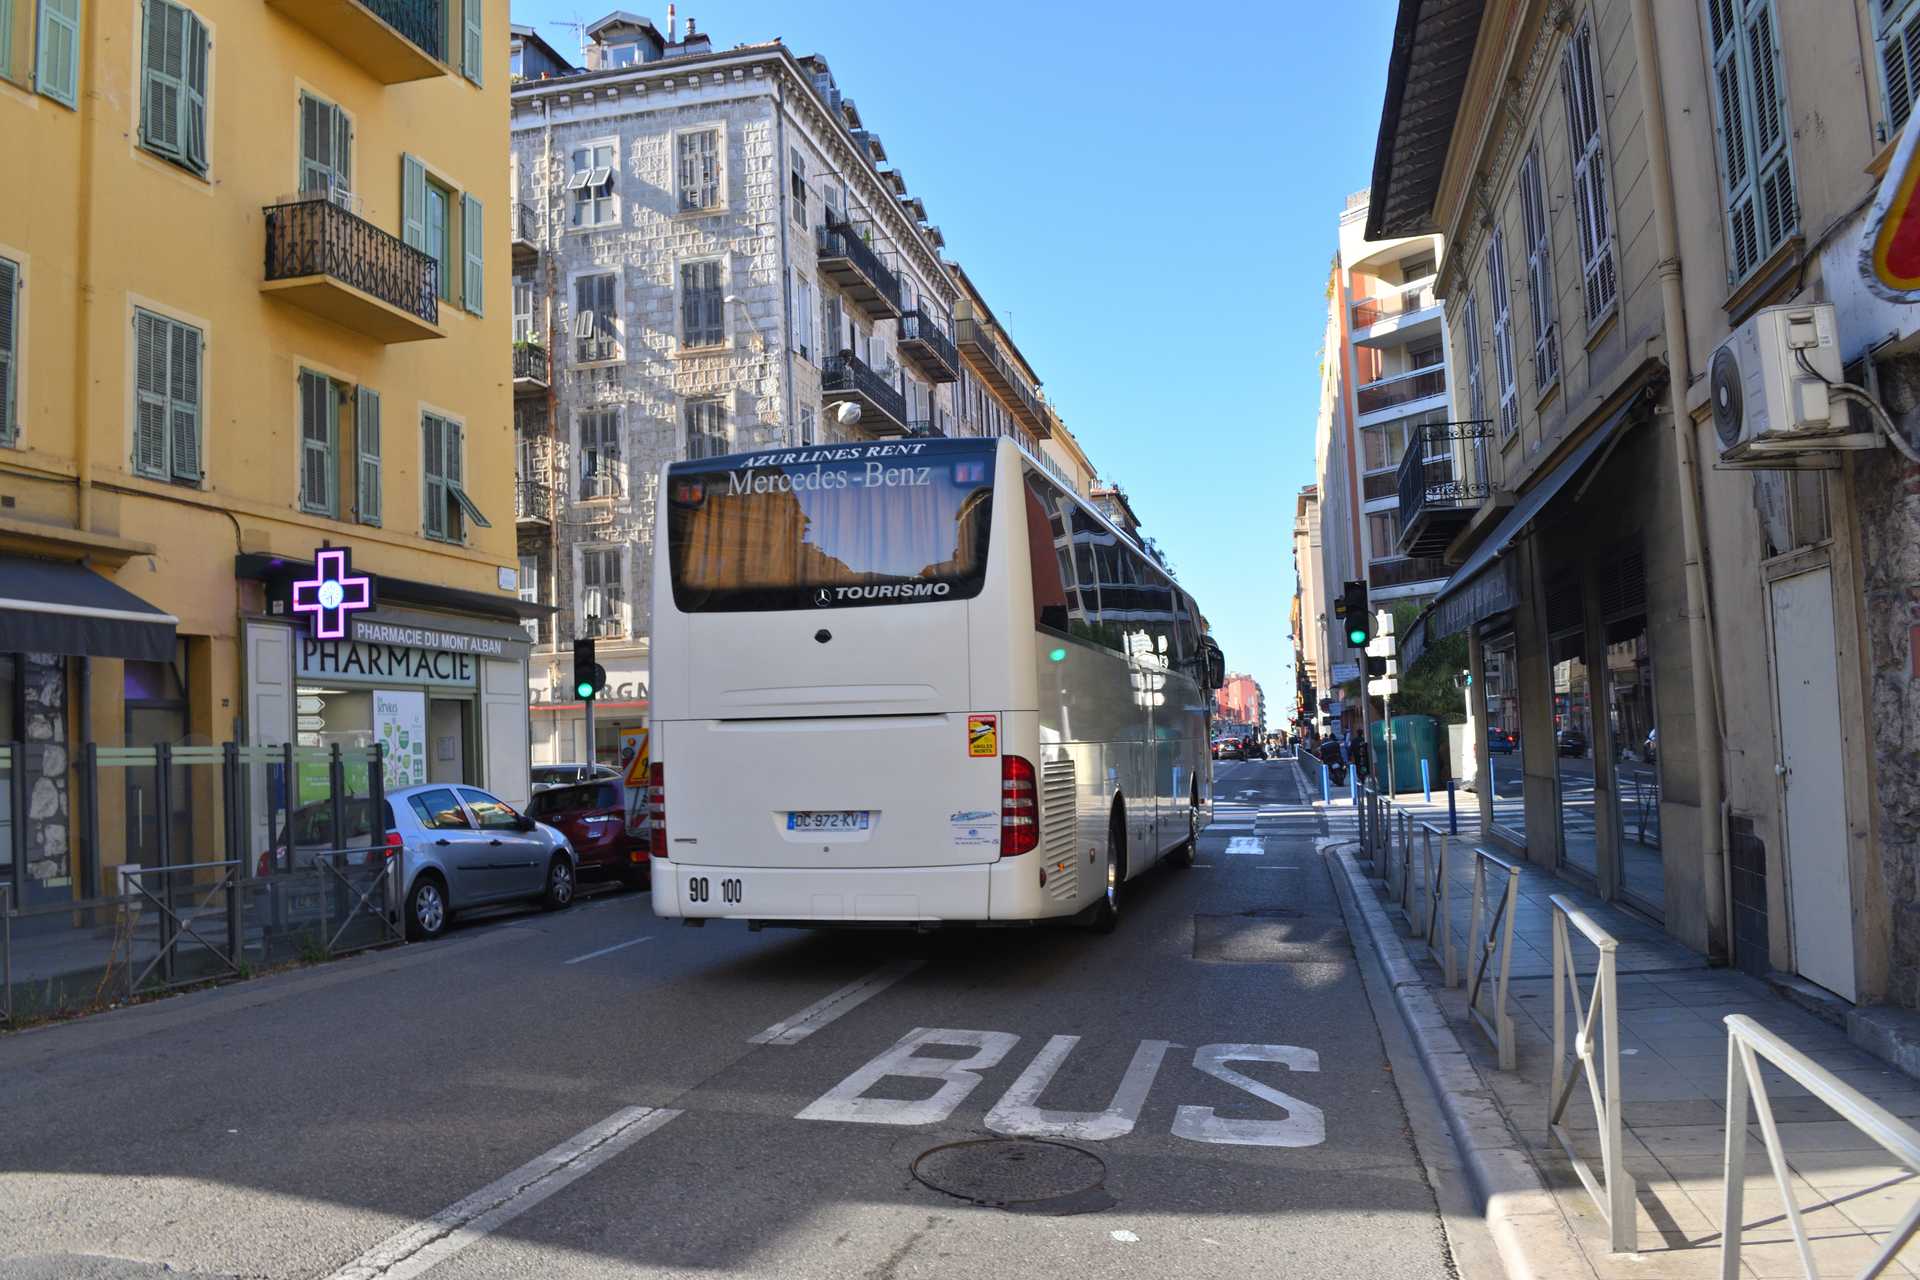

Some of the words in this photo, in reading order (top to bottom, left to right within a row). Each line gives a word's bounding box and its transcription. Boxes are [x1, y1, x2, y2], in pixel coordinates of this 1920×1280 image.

[740, 454, 797, 468] AZUR
[799, 447, 862, 463] LINES
[865, 443, 926, 458] RENT
[727, 461, 931, 496] Mercedes-Benz
[836, 582, 950, 600] TOURISMO
[357, 623, 423, 646] PHARMACIE
[424, 632, 439, 647] DU
[441, 635, 469, 650] MONT
[470, 638, 501, 655] ALBAN
[303, 638, 471, 681] PHARMACIE
[795, 814, 858, 828] DC-972-KV
[689, 877, 710, 903] 90
[721, 878, 742, 904] 100
[794, 1027, 1326, 1147] BUS
